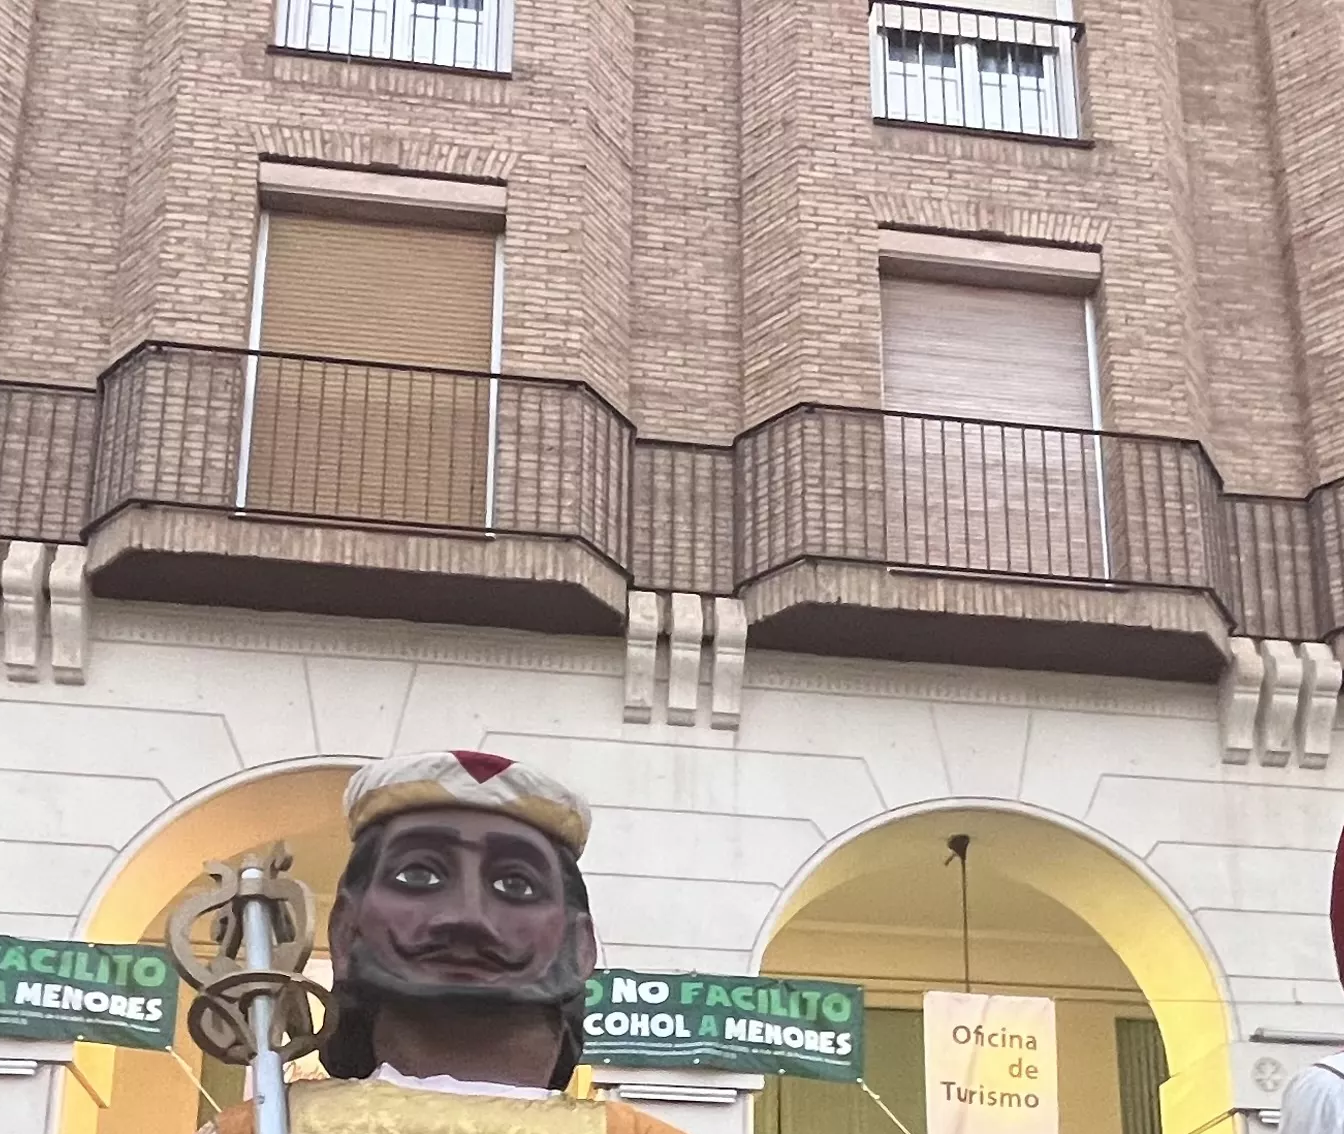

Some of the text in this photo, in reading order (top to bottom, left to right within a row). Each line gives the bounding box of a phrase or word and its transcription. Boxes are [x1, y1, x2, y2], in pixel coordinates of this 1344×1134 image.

[14, 981, 163, 1022] MENORES
[612, 977, 669, 1005] NO
[680, 982, 852, 1022] FACILITO
[583, 1011, 692, 1038] COHOL
[698, 1014, 719, 1037] A
[725, 1015, 852, 1056] MENORES
[952, 1024, 1037, 1051] Oficina
[1008, 1057, 1039, 1079] de
[939, 1081, 1040, 1108] Turismo
